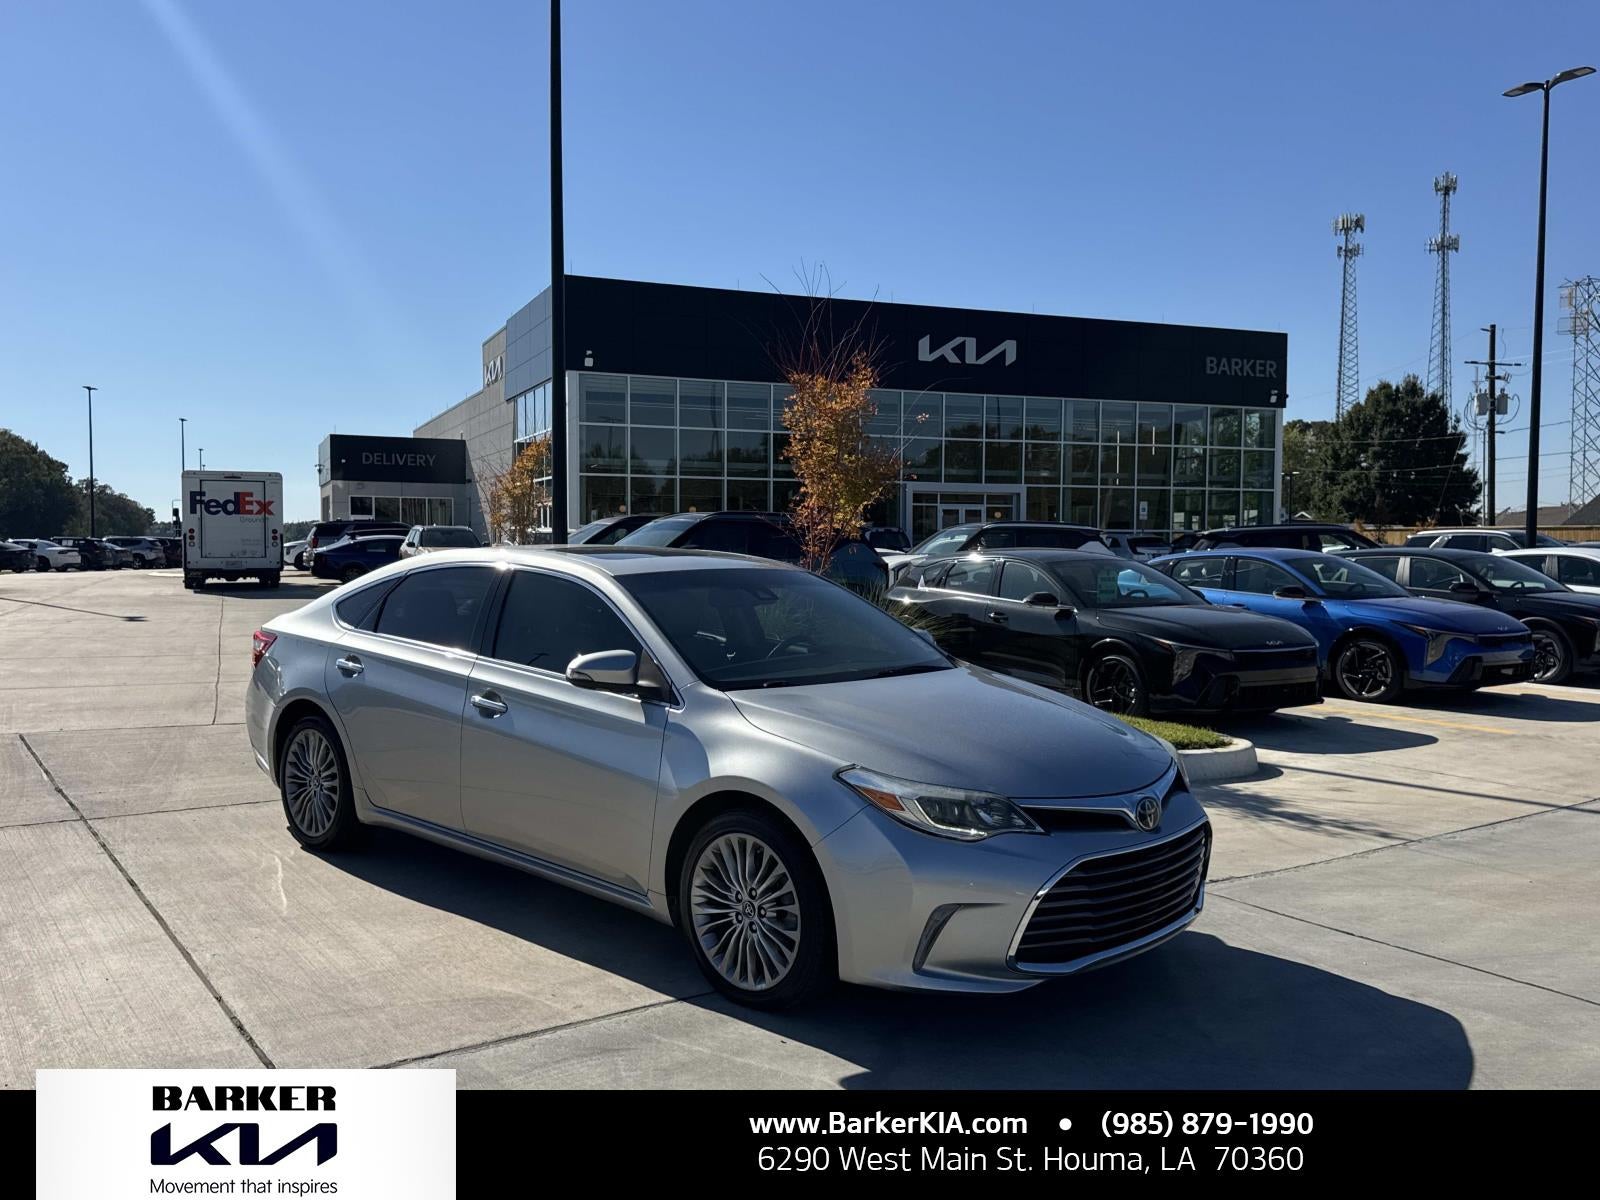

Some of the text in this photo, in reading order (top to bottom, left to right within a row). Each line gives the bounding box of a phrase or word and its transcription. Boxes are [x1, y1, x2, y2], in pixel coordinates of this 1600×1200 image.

[918, 334, 1017, 367] KIA
[1205, 356, 1278, 379] BARKER
[361, 452, 437, 467] DELIVERY
[189, 490, 275, 516] FedEx
